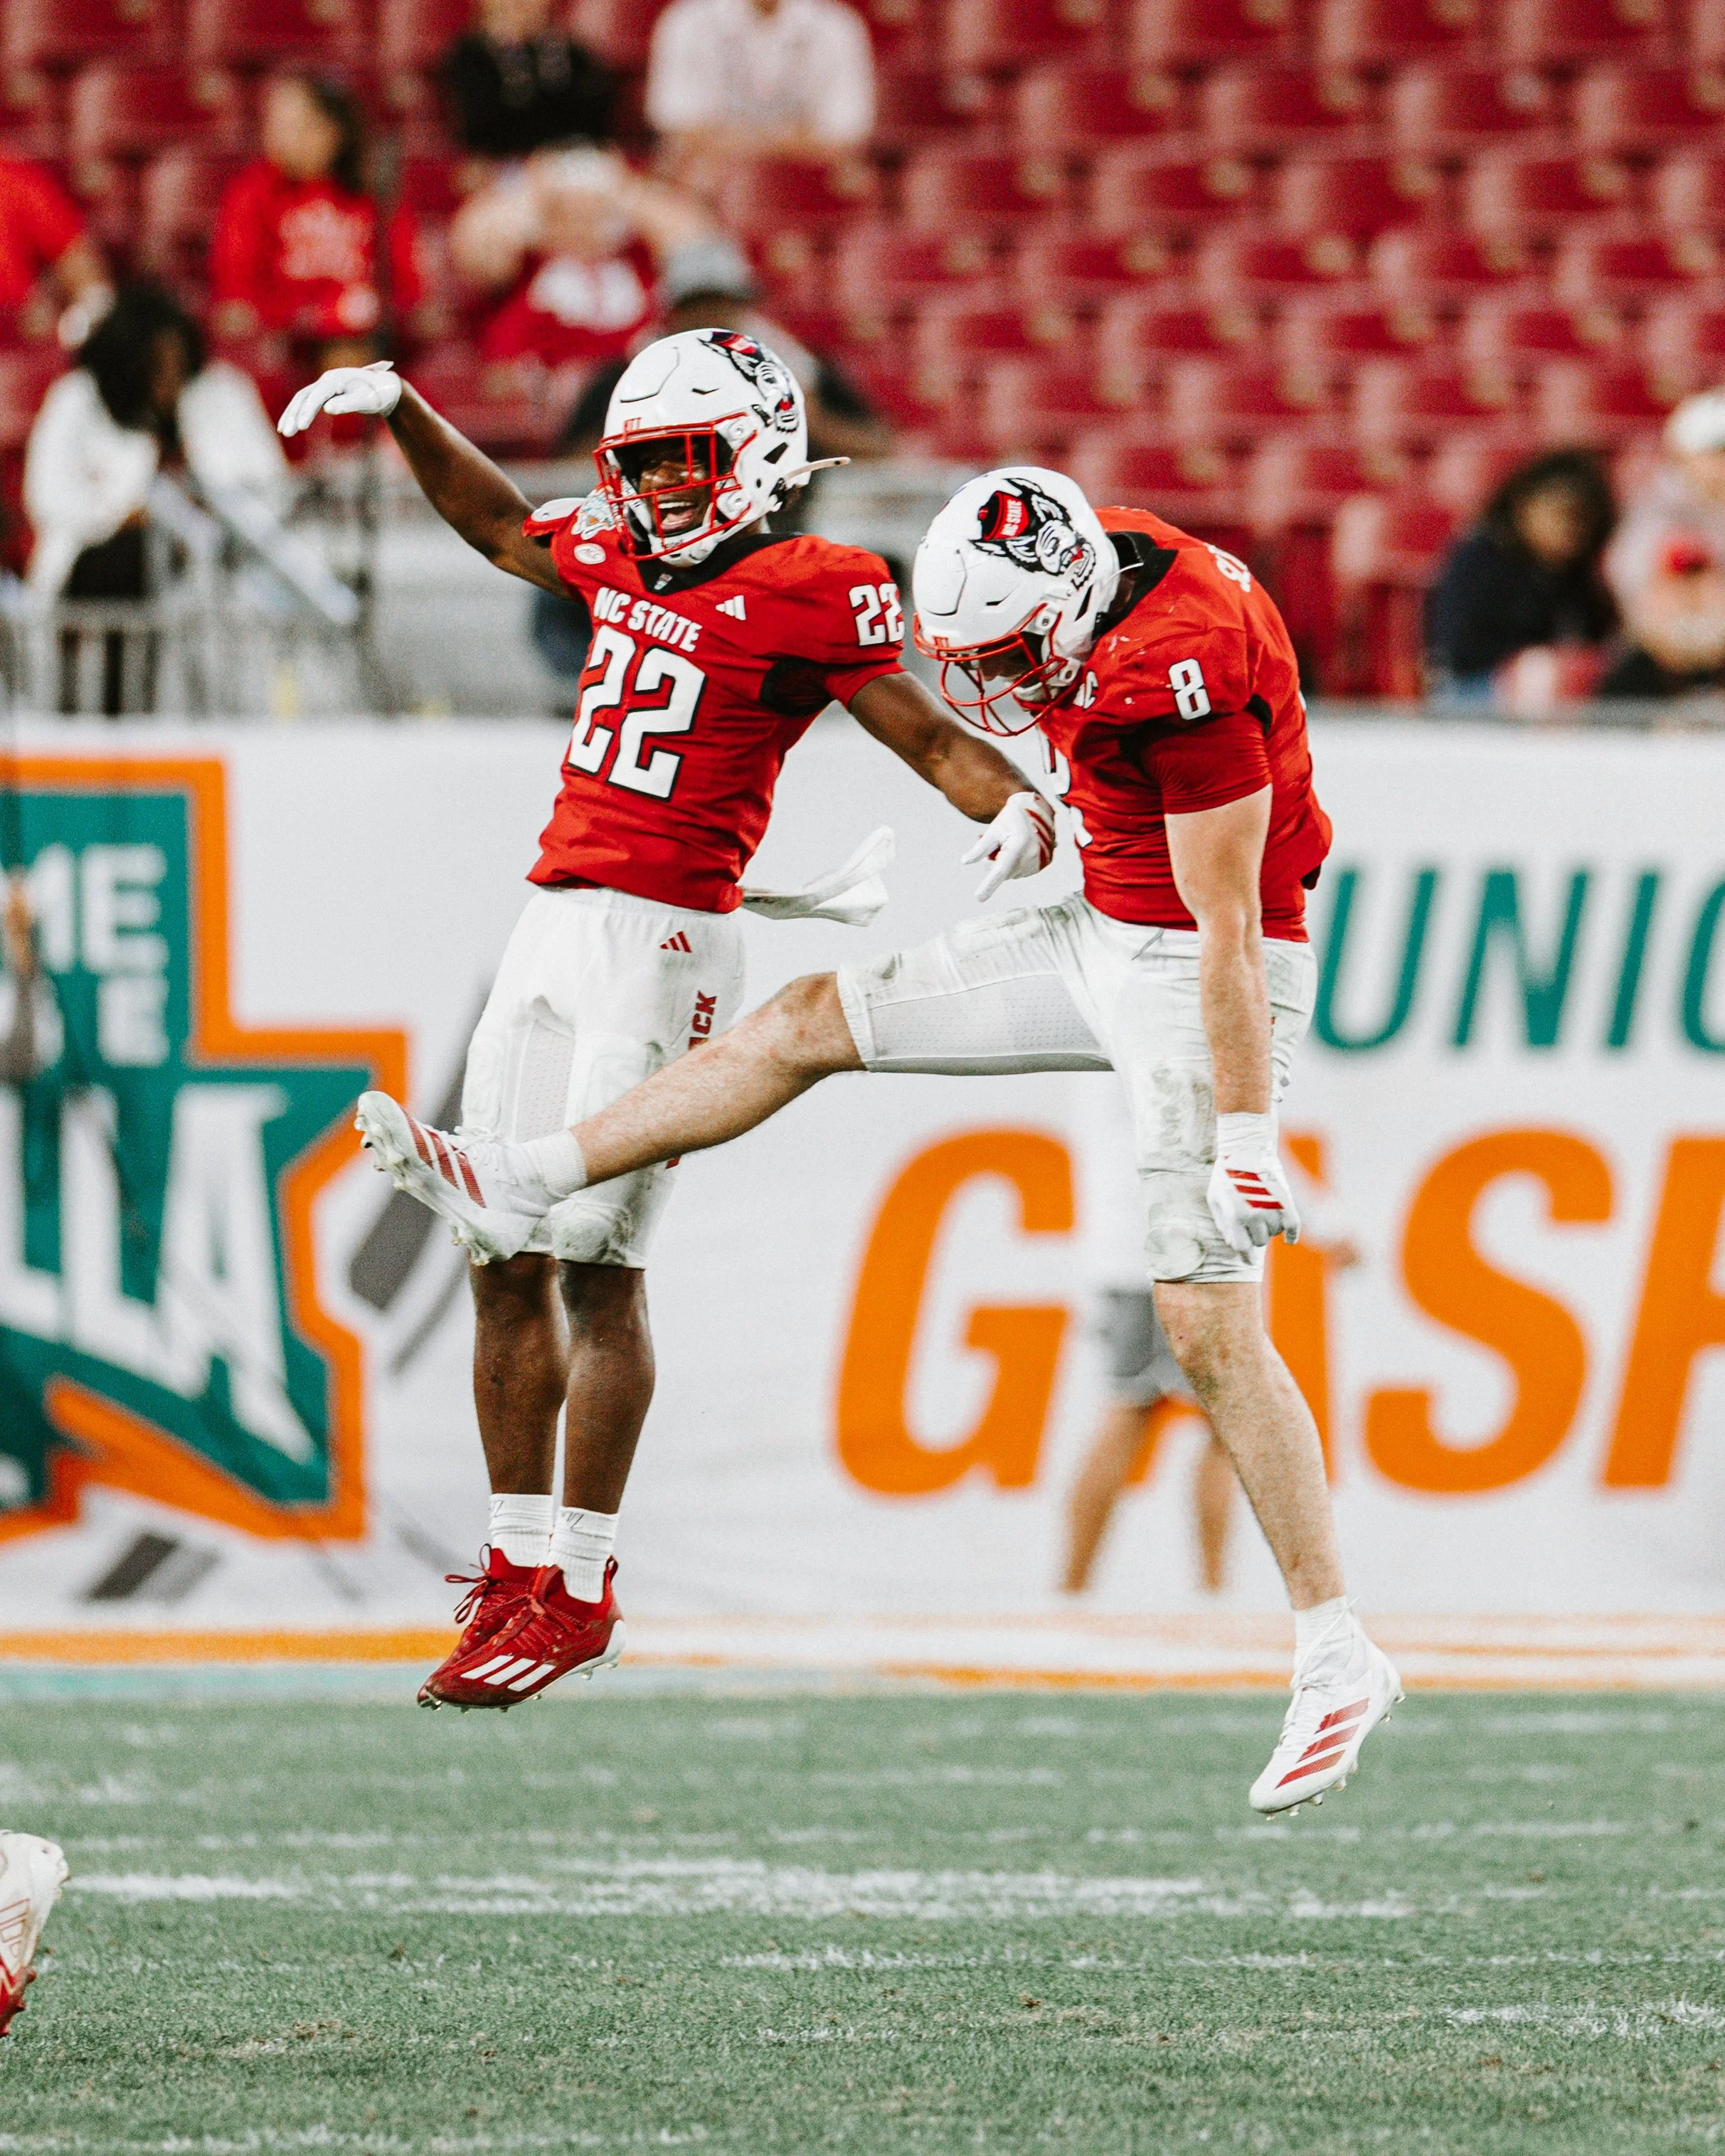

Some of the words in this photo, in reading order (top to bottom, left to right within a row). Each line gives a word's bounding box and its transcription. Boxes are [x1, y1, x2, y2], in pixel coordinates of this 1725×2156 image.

[593, 586, 632, 624] NC
[627, 600, 704, 652] STATE
[848, 582, 906, 647] 22
[567, 624, 706, 802] 22
[1168, 657, 1212, 721] 8
